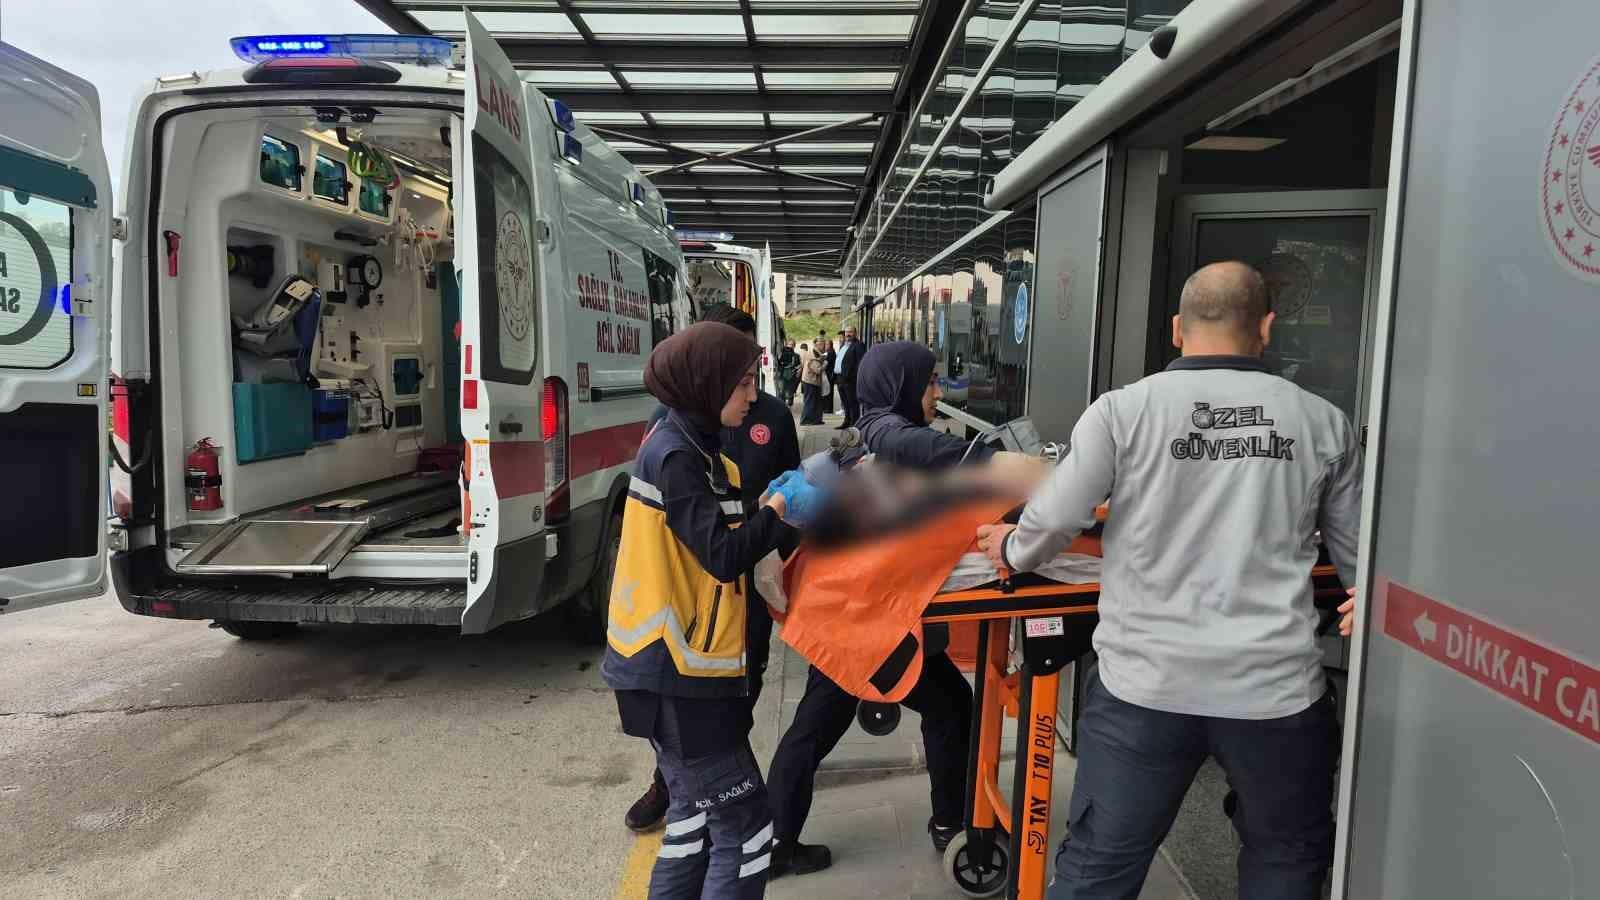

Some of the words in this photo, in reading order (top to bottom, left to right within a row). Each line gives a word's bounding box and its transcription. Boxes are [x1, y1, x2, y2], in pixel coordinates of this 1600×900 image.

[474, 64, 521, 141] LANS
[1571, 103, 1600, 166] CUMHU
[578, 272, 611, 312] SAĞLIK
[597, 317, 615, 353] ACİL
[617, 322, 641, 355] SAĞLIK
[1191, 402, 1274, 429] ÖZEL
[1171, 431, 1295, 460] GÜVENLİK
[1446, 624, 1549, 703] DİKKAT
[1035, 713, 1053, 750] PLUS
[1033, 753, 1050, 769] 10
[1033, 771, 1049, 780] T
[1030, 796, 1047, 825] TAY
